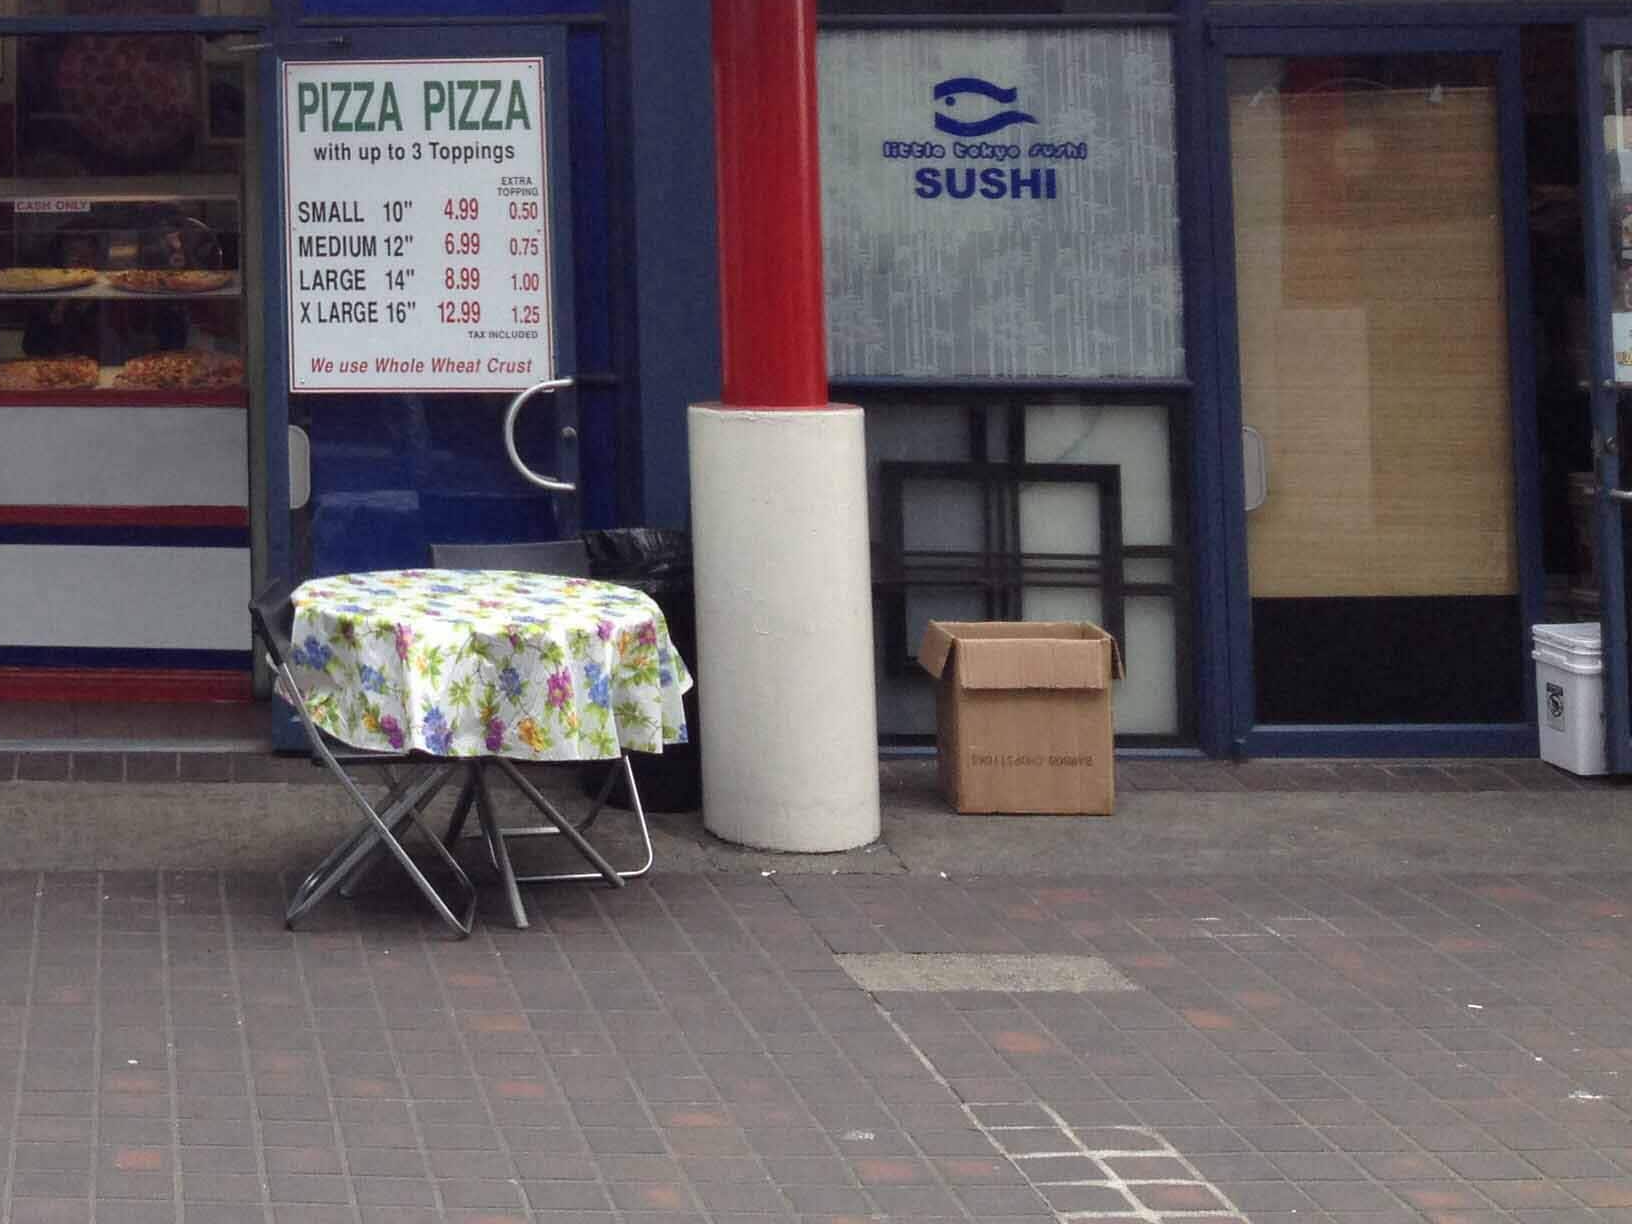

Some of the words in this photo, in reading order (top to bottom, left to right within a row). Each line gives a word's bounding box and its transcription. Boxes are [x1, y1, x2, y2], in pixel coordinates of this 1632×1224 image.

[298, 81, 403, 132] PIZZA
[424, 80, 531, 130] PIZZA
[314, 143, 351, 161] with
[359, 146, 381, 164] up
[388, 144, 405, 160] to
[412, 144, 422, 160] 3
[428, 142, 515, 164] Toppings
[883, 142, 945, 158] little
[954, 142, 1020, 161] tokyo
[1028, 142, 1088, 159] sushi
[498, 188, 539, 197] TOPPING
[501, 177, 532, 186] EXTRA
[914, 167, 1056, 199] SUSHI
[298, 202, 364, 222] SMALL
[383, 202, 413, 222] 10"
[444, 198, 479, 220] 4.99
[509, 203, 538, 219] 0.50
[299, 236, 377, 257] MEDIUM
[384, 236, 413, 256] 12"
[445, 233, 480, 255] 6.99
[510, 238, 539, 255] 0.75
[299, 270, 366, 290] LARGE
[386, 270, 415, 290] 14"
[445, 267, 480, 289] 8.99
[512, 274, 539, 291] 1.00
[300, 302, 311, 323] X
[318, 302, 378, 323] LARGE
[387, 302, 416, 323] 16"
[438, 302, 481, 324] 12.99
[512, 306, 540, 323] 1.25
[468, 331, 486, 339] TAX
[488, 331, 538, 339] INCLUDED
[311, 359, 334, 373] We
[340, 362, 367, 373] use
[375, 359, 424, 373] Whole
[432, 359, 480, 373] Wheat
[487, 358, 532, 373] Crust
